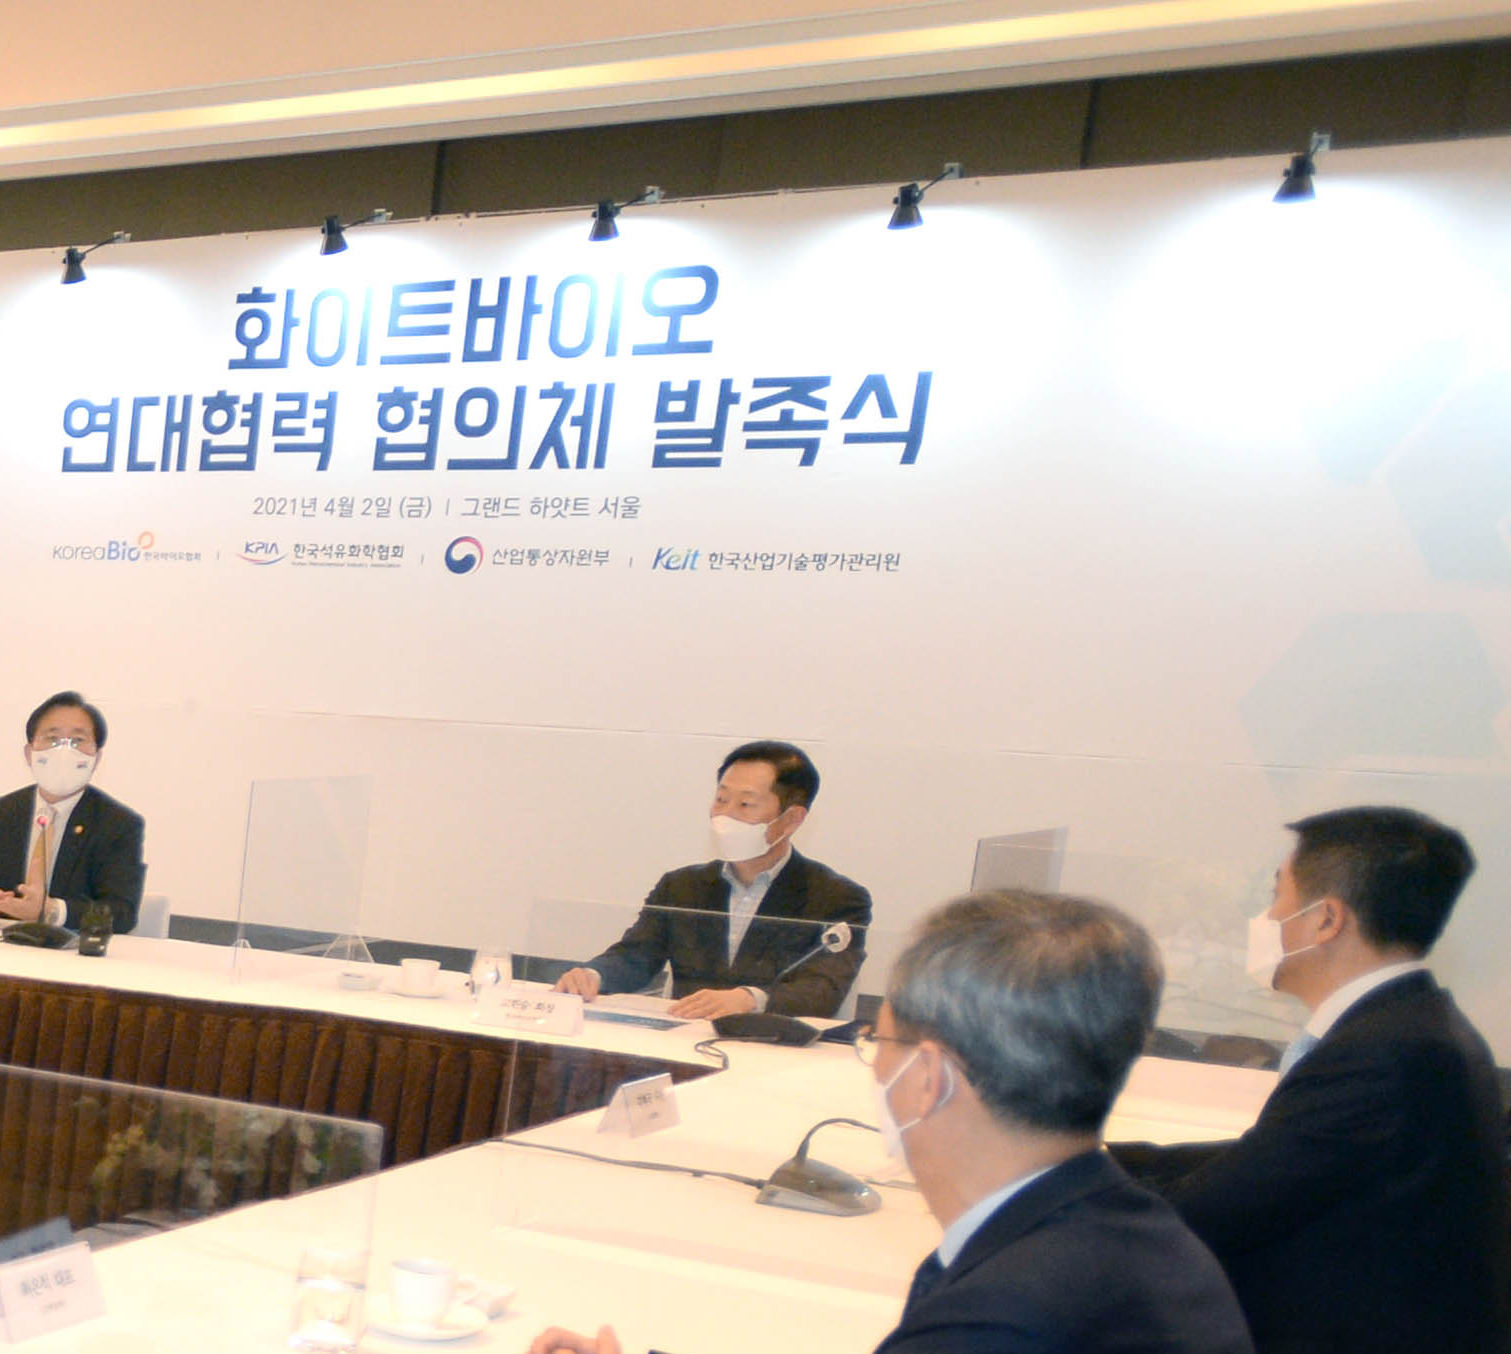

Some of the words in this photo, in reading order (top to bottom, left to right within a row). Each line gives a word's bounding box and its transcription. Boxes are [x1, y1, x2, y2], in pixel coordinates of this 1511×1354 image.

[228, 263, 720, 371] 화이트바이오
[60, 390, 338, 473] 연대협력
[372, 380, 615, 472] 협의체
[650, 370, 933, 468] 발족식
[252, 496, 317, 518] 2021년
[323, 496, 355, 518] 4월
[360, 496, 391, 518] 2일
[399, 496, 432, 519] (금)
[461, 496, 521, 518] 그랜드
[529, 496, 591, 519] 하얏트
[597, 496, 641, 519] 서울
[293, 543, 404, 561] 한국석유화학협회
[492, 548, 610, 567] 산업통상자원부
[708, 551, 901, 572] 한국산업기술평가관리원
